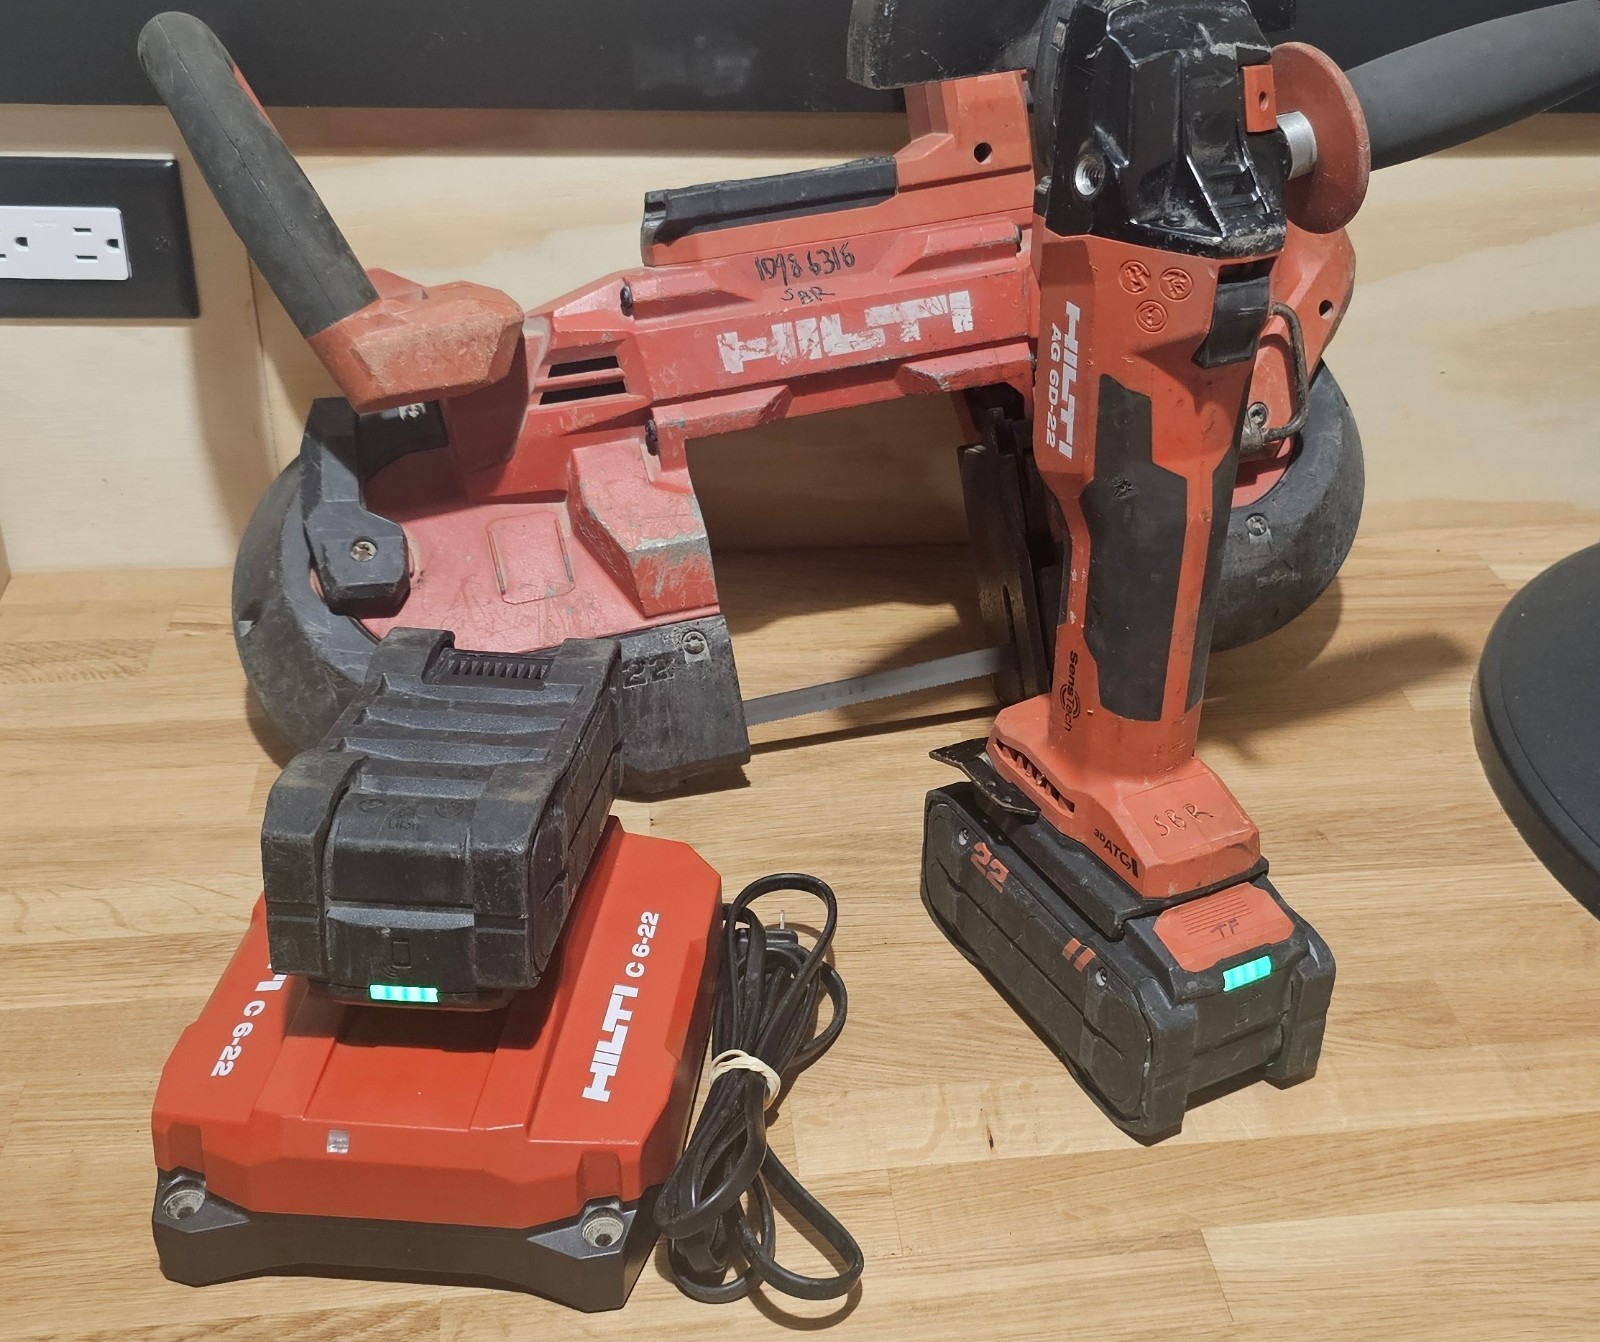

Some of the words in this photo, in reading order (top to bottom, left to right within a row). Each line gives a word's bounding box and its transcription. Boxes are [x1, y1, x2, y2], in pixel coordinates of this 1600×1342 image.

[716, 290, 974, 373] HILTI
[1050, 322, 1062, 363] AG
[1058, 300, 1081, 460] HILTI
[1046, 368, 1060, 448] 6D-22
[1153, 803, 1215, 837] SBR
[970, 841, 1010, 894] 22
[631, 911, 660, 958] 6-22
[625, 961, 645, 978] C
[243, 1000, 266, 1017] C
[211, 1022, 254, 1077] 6-22
[582, 984, 640, 1103] HILTI
